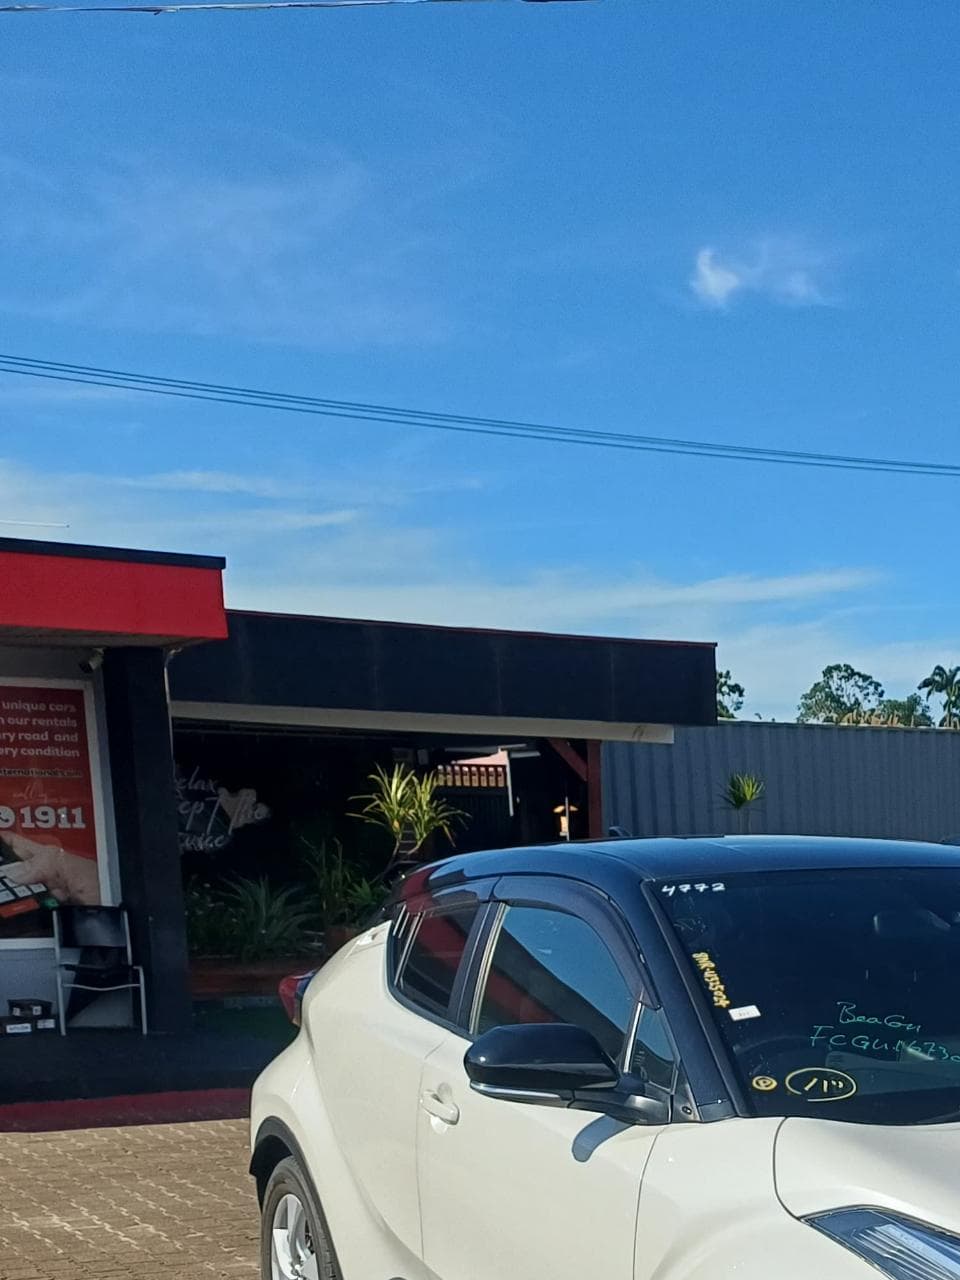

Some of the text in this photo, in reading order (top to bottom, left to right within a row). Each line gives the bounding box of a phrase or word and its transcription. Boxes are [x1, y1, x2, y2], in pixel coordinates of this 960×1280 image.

[2, 700, 77, 713] unique cars
[8, 717, 30, 726] our
[32, 717, 77, 728] rentals
[19, 731, 49, 741] road
[54, 733, 79, 742] and
[21, 746, 80, 757] condition
[20, 805, 86, 829] 1911
[661, 882, 726, 896] 4772
